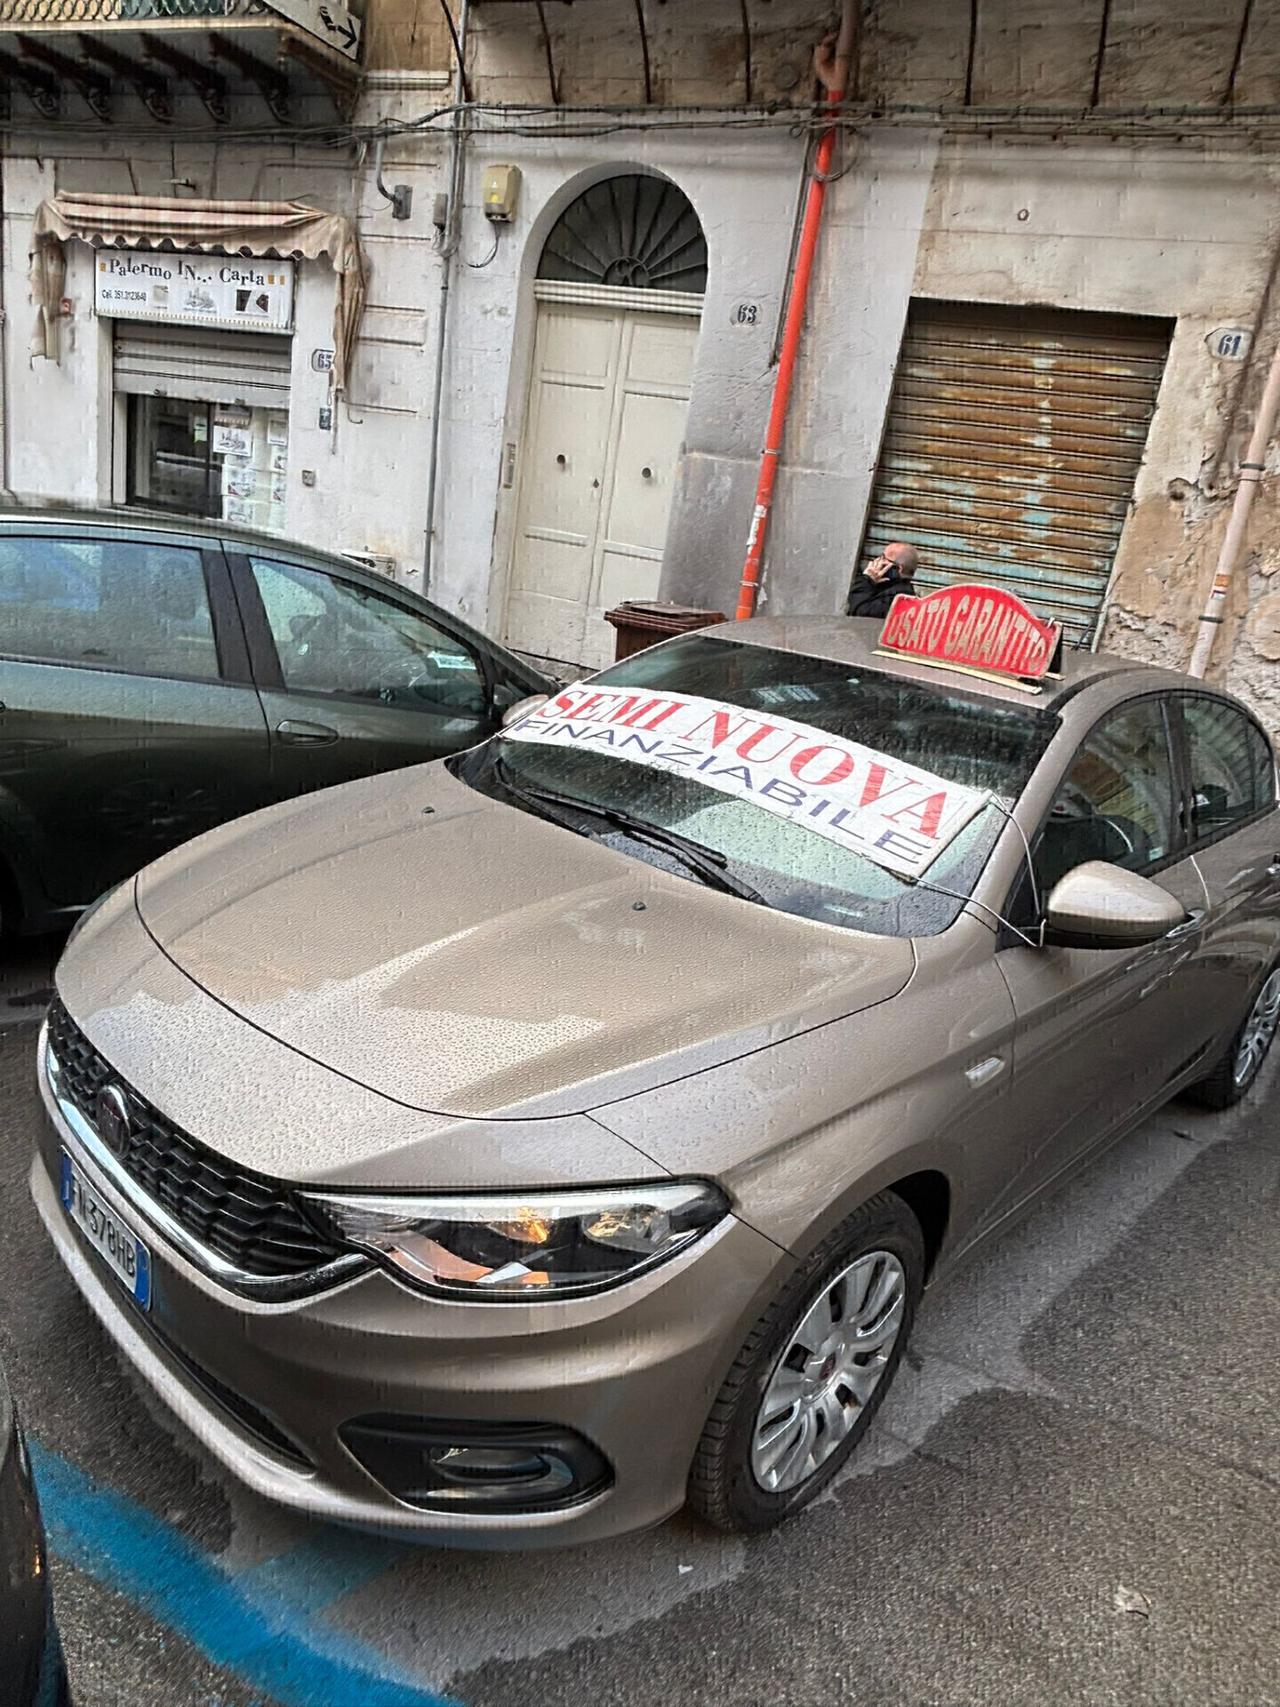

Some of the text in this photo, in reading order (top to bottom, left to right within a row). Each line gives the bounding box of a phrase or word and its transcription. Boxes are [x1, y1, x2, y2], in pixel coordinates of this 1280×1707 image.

[109, 257, 172, 280] Palermo
[219, 267, 265, 286] Carta
[737, 303, 757, 324] 63
[1217, 334, 1242, 357] 61
[886, 594, 1046, 672] USATO GARANTITO
[514, 718, 933, 865] FINANZIABILE
[534, 690, 947, 840] SEMI NUOVA
